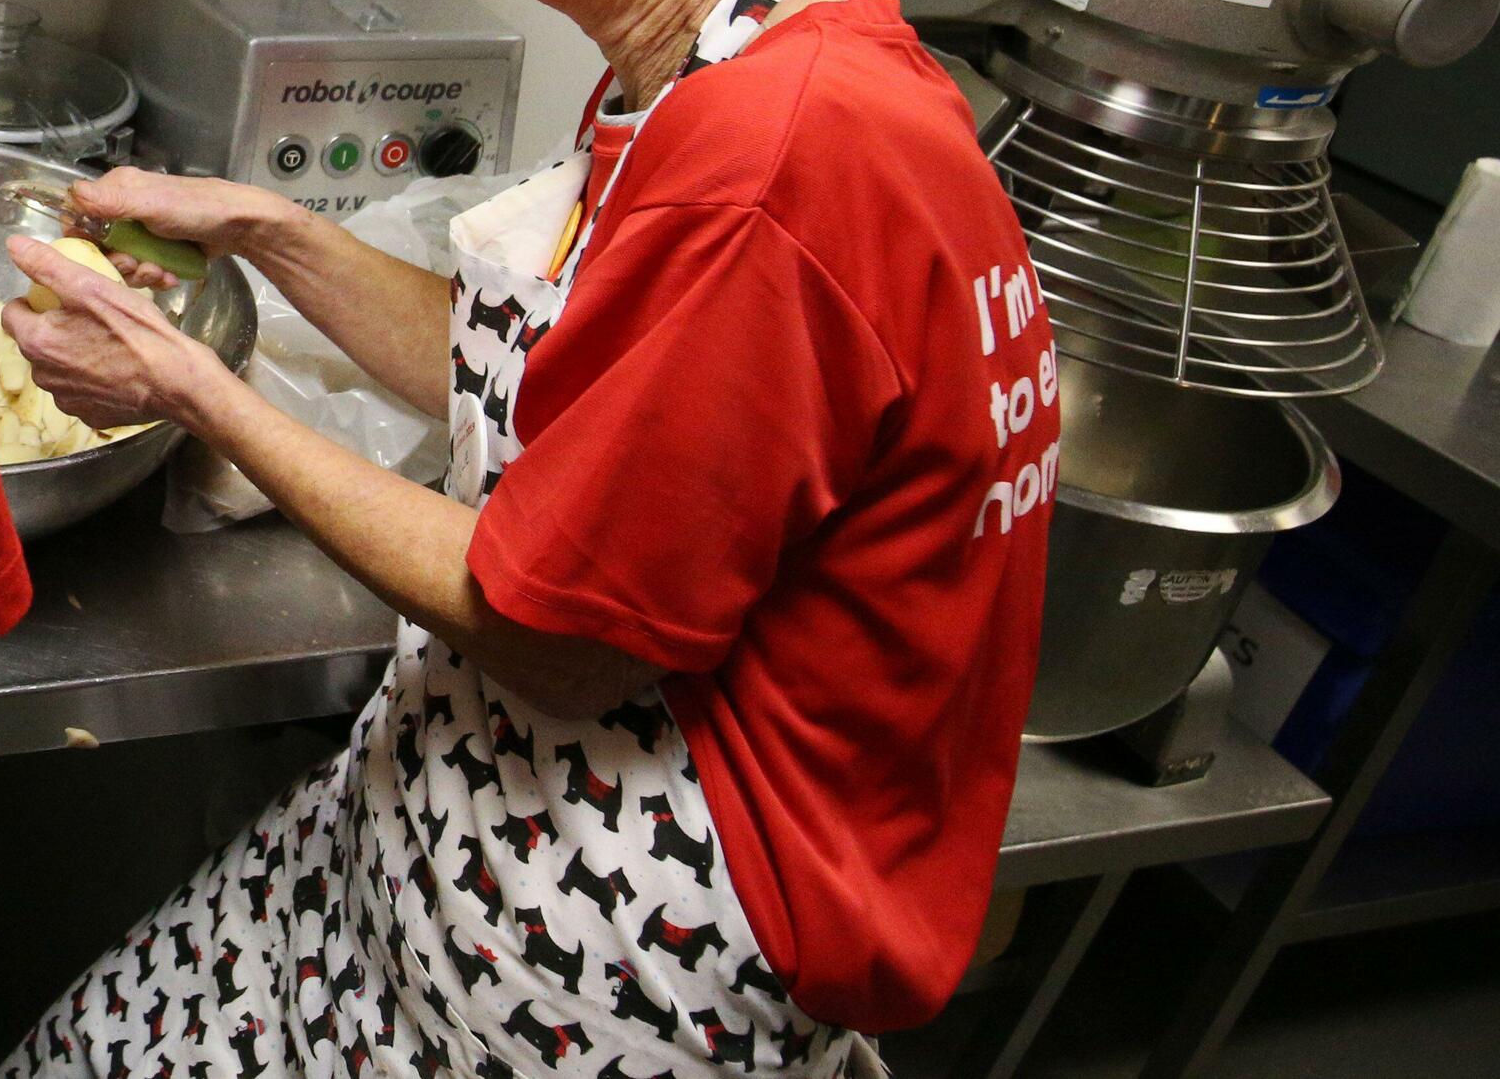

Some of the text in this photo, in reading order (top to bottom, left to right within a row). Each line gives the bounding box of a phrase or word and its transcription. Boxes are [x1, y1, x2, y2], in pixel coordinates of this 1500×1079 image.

[281, 80, 463, 105] robot coupe
[973, 264, 1035, 356] I'm
[990, 376, 1035, 450] to
